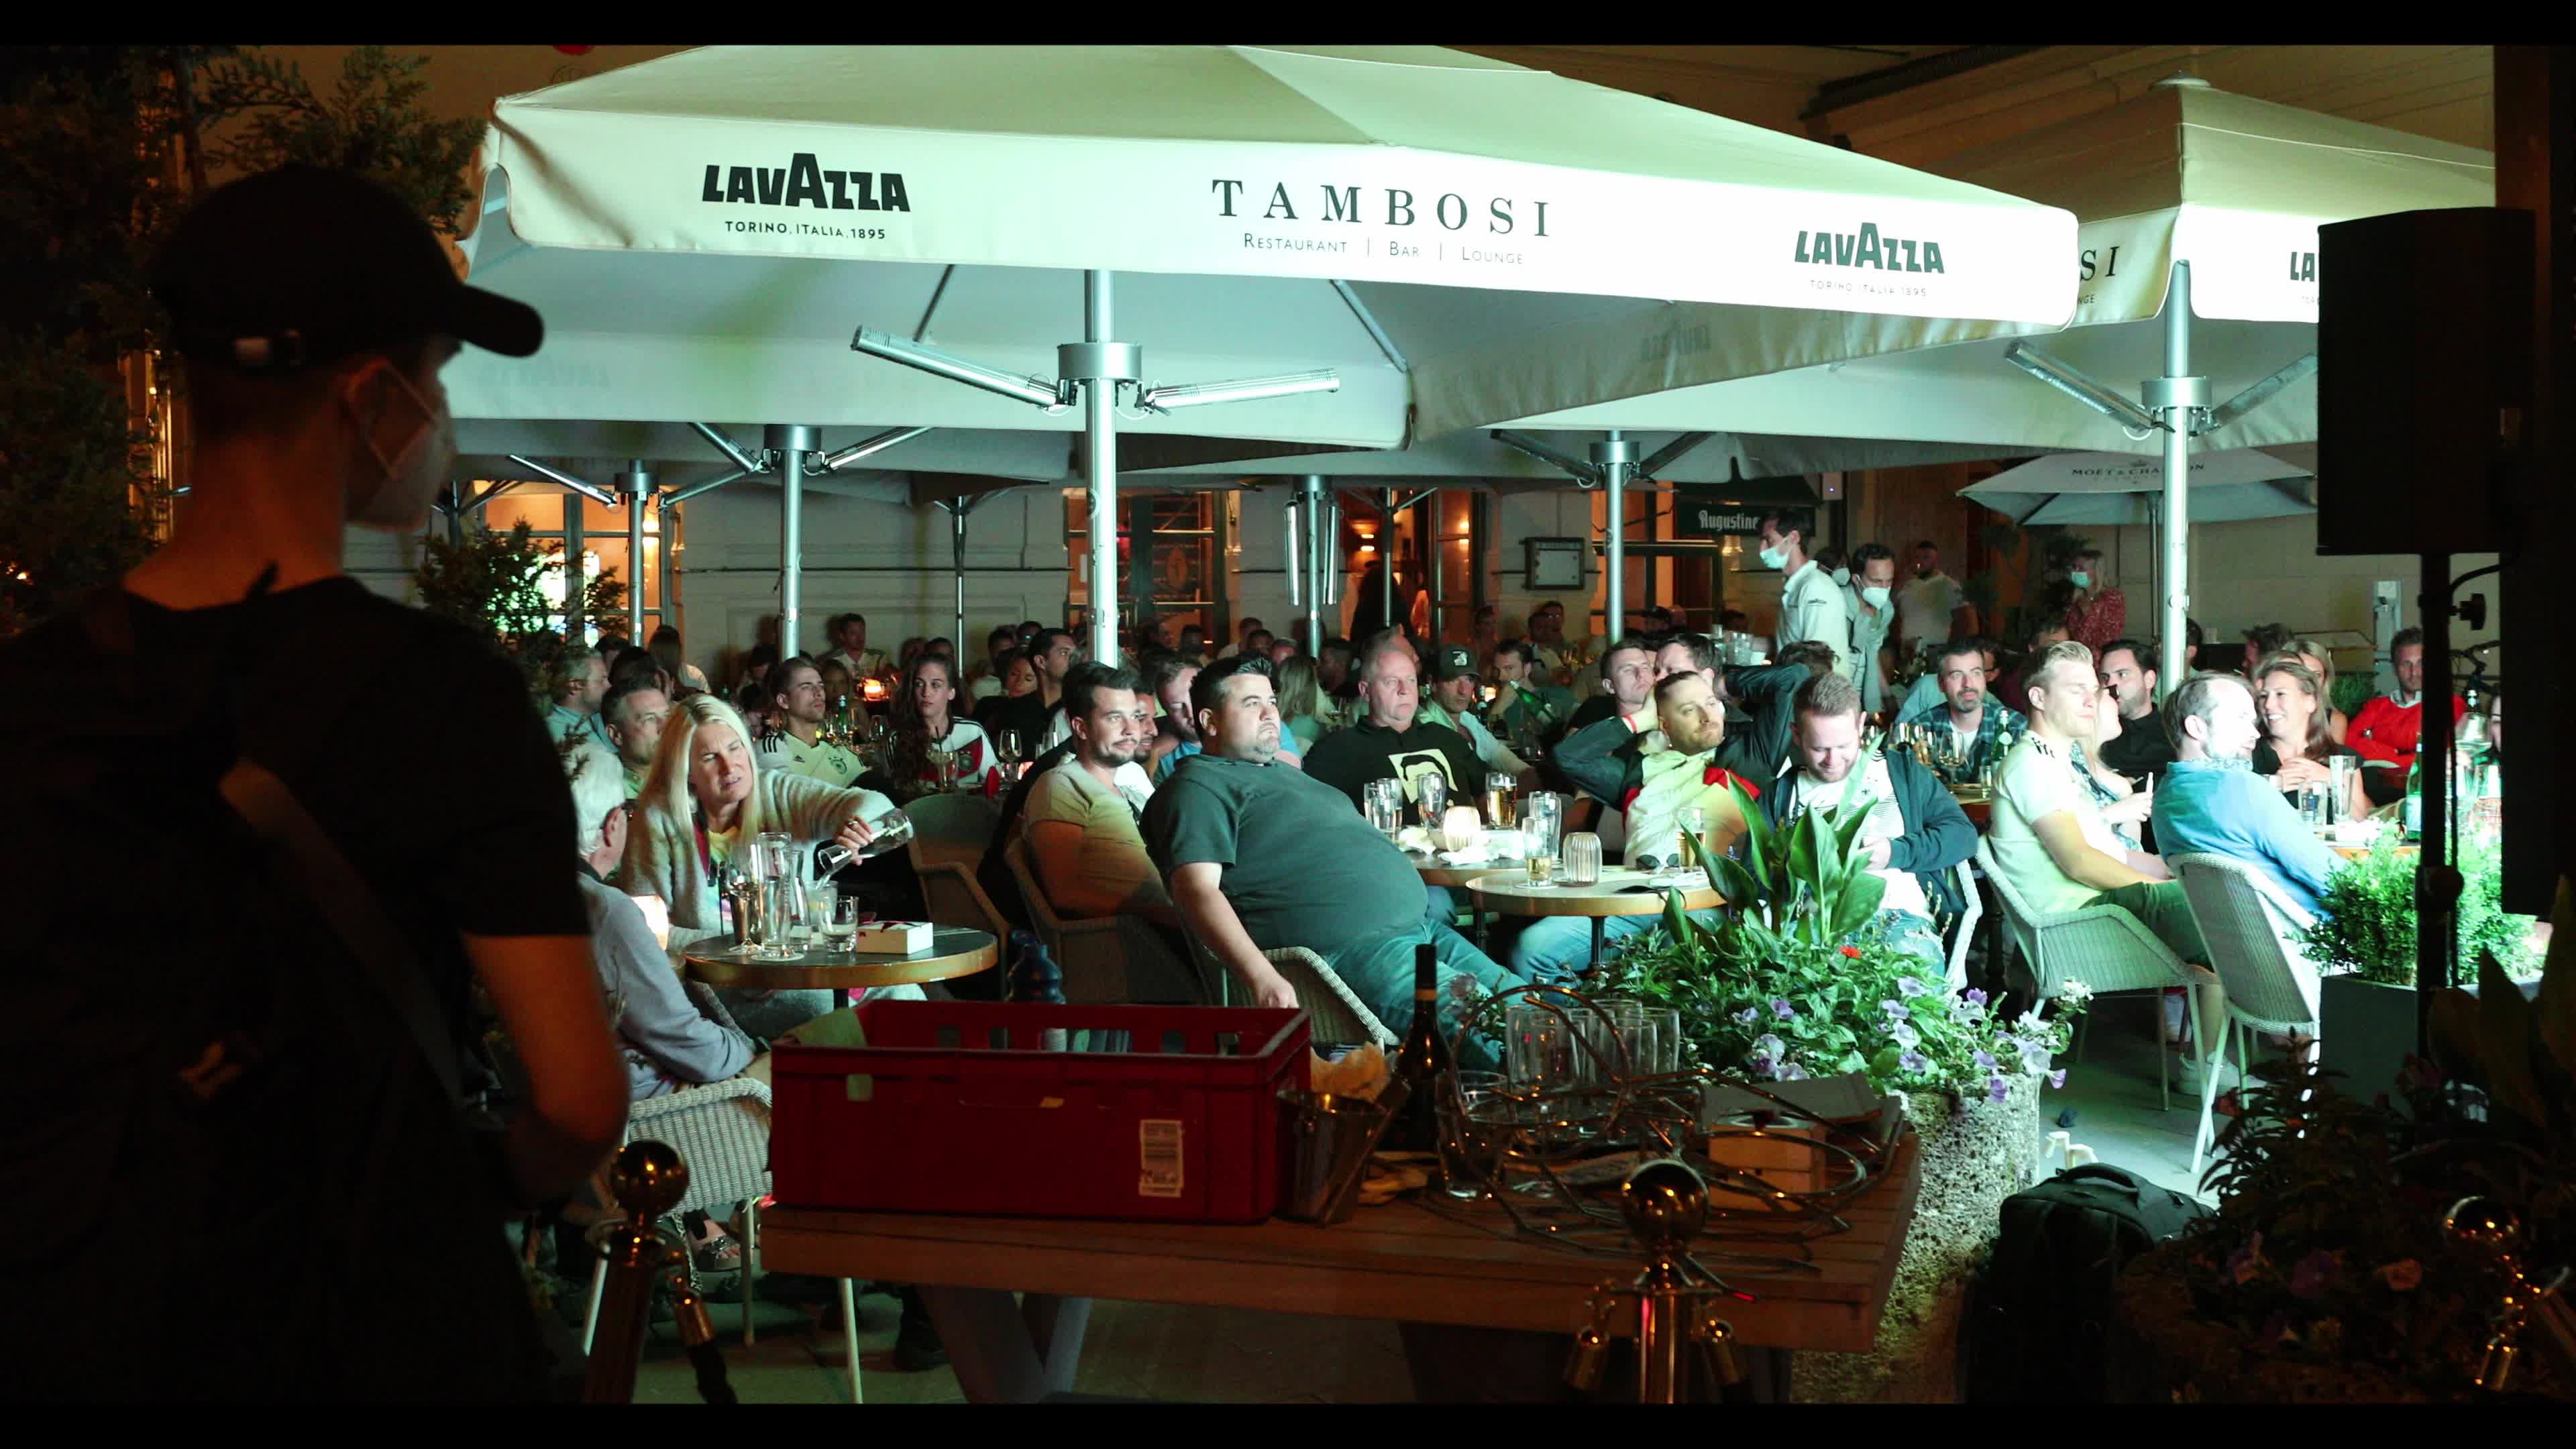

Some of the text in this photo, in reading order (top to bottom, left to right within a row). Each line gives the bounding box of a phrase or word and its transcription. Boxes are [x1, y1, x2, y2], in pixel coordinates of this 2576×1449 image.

[702, 153, 910, 212] LAVAZZA
[1212, 179, 1550, 237] TAMBOSI
[1794, 222, 1945, 274] LAVAZZA
[1698, 509, 1762, 531] Augustine
